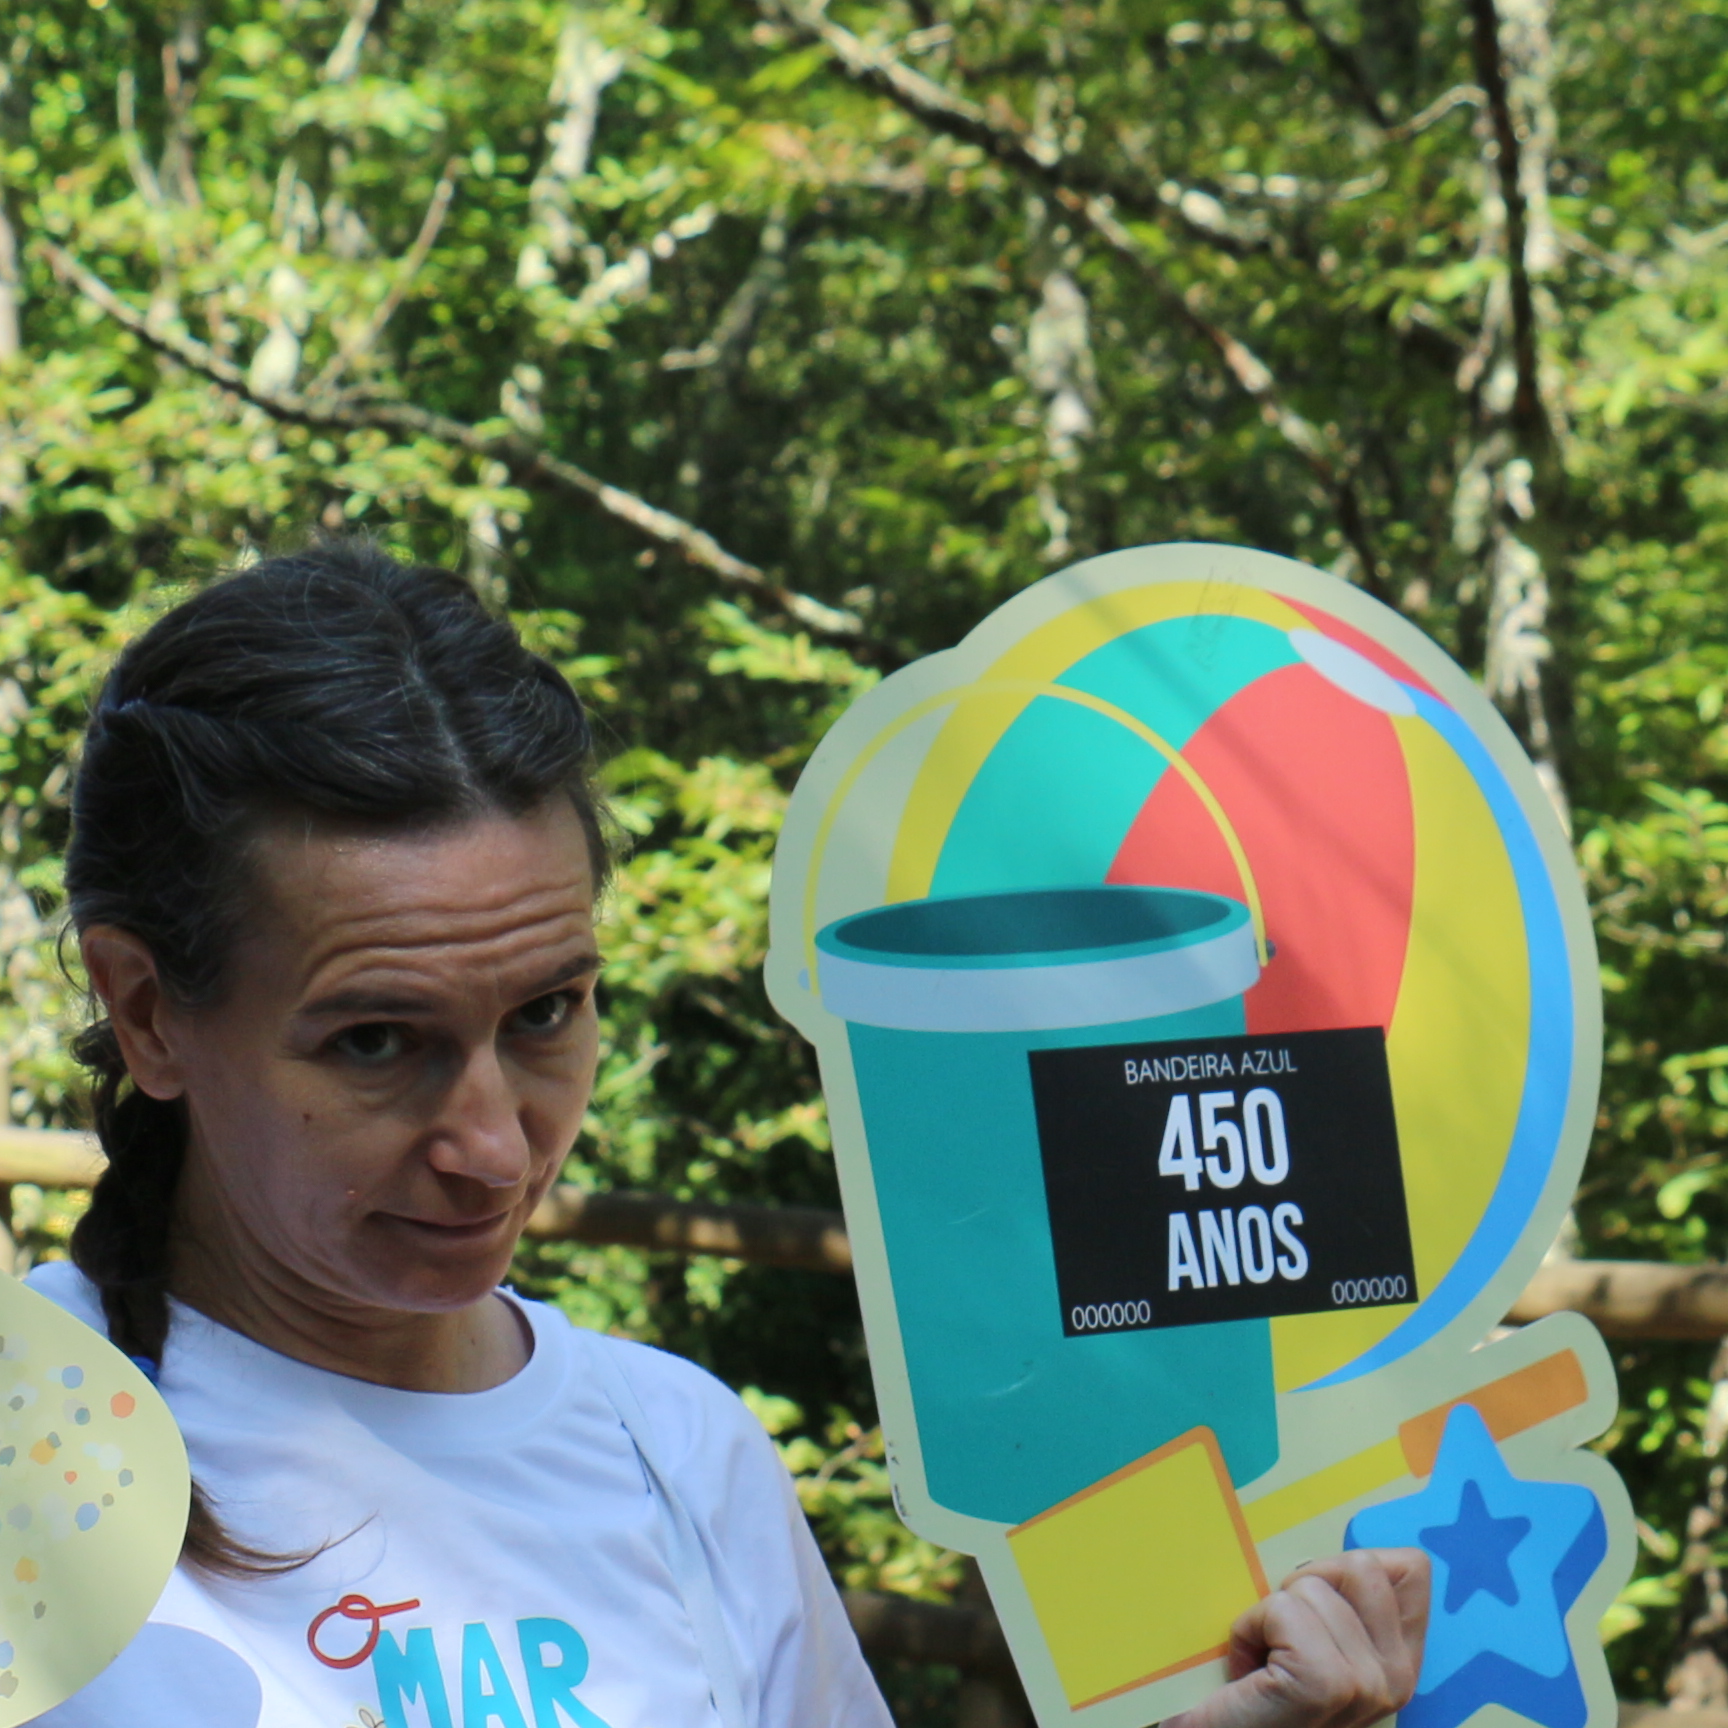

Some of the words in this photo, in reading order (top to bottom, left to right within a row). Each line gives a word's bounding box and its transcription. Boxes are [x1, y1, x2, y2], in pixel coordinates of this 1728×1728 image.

[1124, 1049, 1236, 1085] BANDEIRA
[1240, 1048, 1298, 1076] AZUL
[1157, 1087, 1290, 1192] 450
[1167, 1201, 1309, 1292] ANOS
[307, 1594, 420, 1669] O
